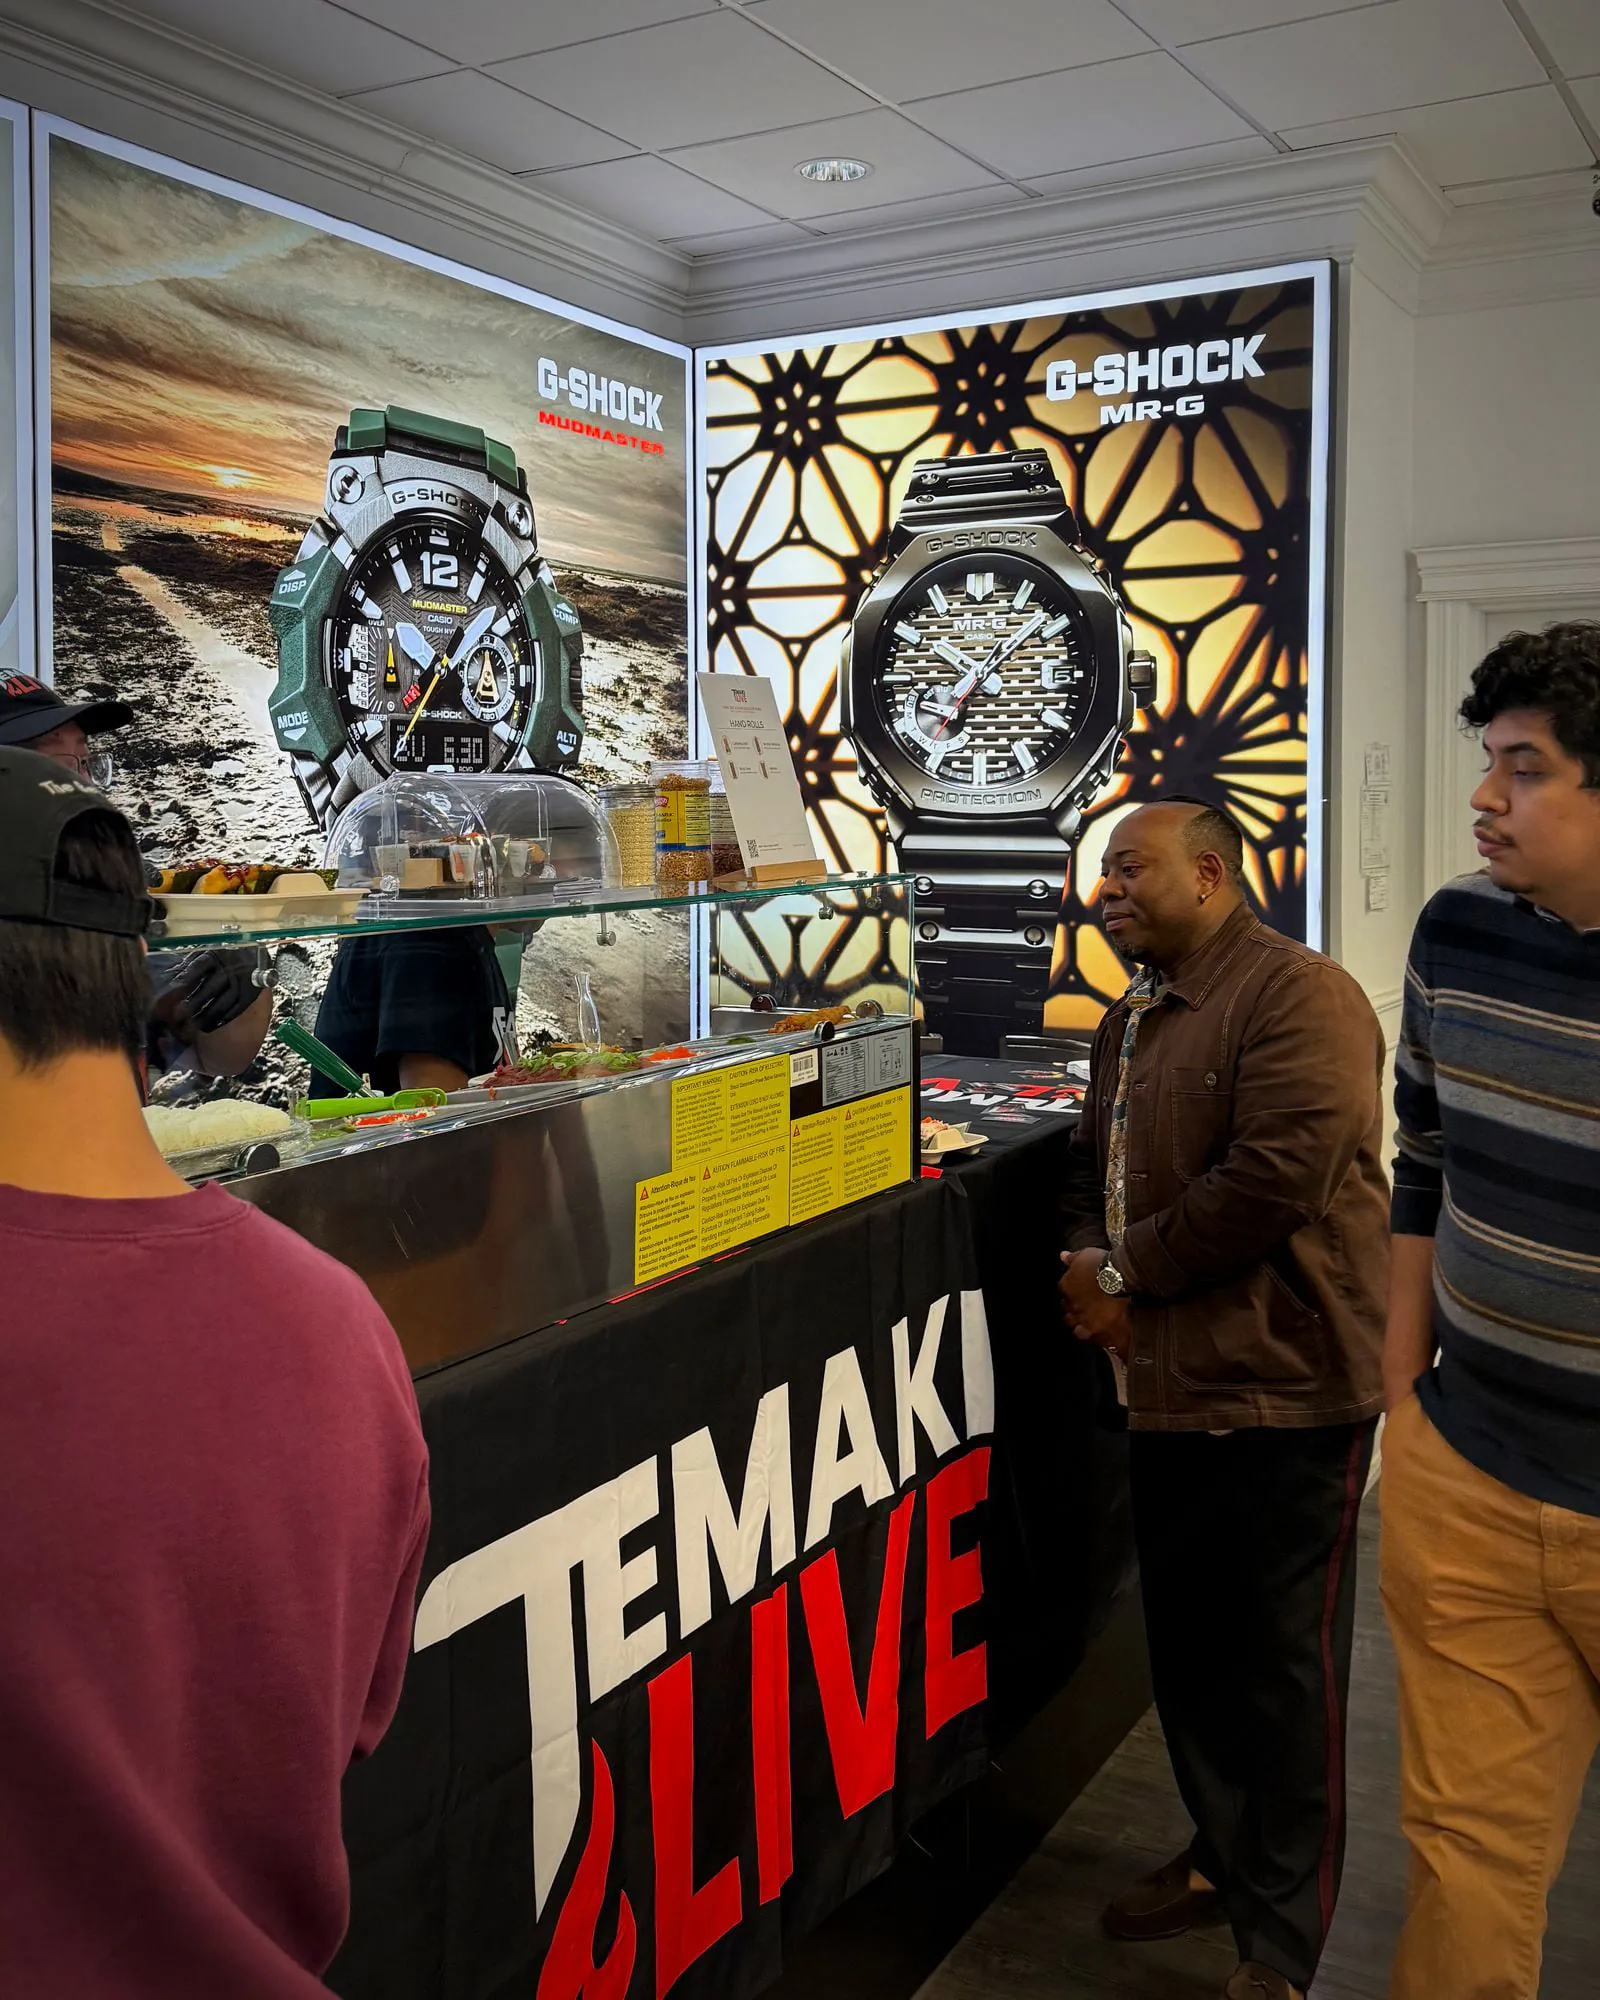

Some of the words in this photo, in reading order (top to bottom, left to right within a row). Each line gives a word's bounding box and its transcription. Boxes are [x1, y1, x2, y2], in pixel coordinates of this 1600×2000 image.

[1046, 334, 1266, 401] G-SHOCK
[538, 357, 664, 431] G-SHOCK
[1100, 395, 1205, 425] MR-G
[538, 409, 665, 457] MUDMASTER
[926, 531, 1037, 553] G-SHOCK
[420, 551, 458, 588] 12
[279, 580, 307, 594] DISP
[412, 599, 468, 614] MUDMASTER
[428, 614, 453, 625] CASIO
[553, 608, 579, 625] COMP
[953, 618, 1007, 631] MR-G
[422, 626, 443, 634] TOUGH
[1054, 670, 1071, 683] 5
[277, 711, 309, 729] MODE
[420, 710, 462, 719] G-SHOCK
[556, 730, 577, 745] ALTI
[921, 788, 1042, 805] PROTECTION
[414, 1288, 995, 1923] TEMAKI
[647, 1447, 992, 2000] LIVE
